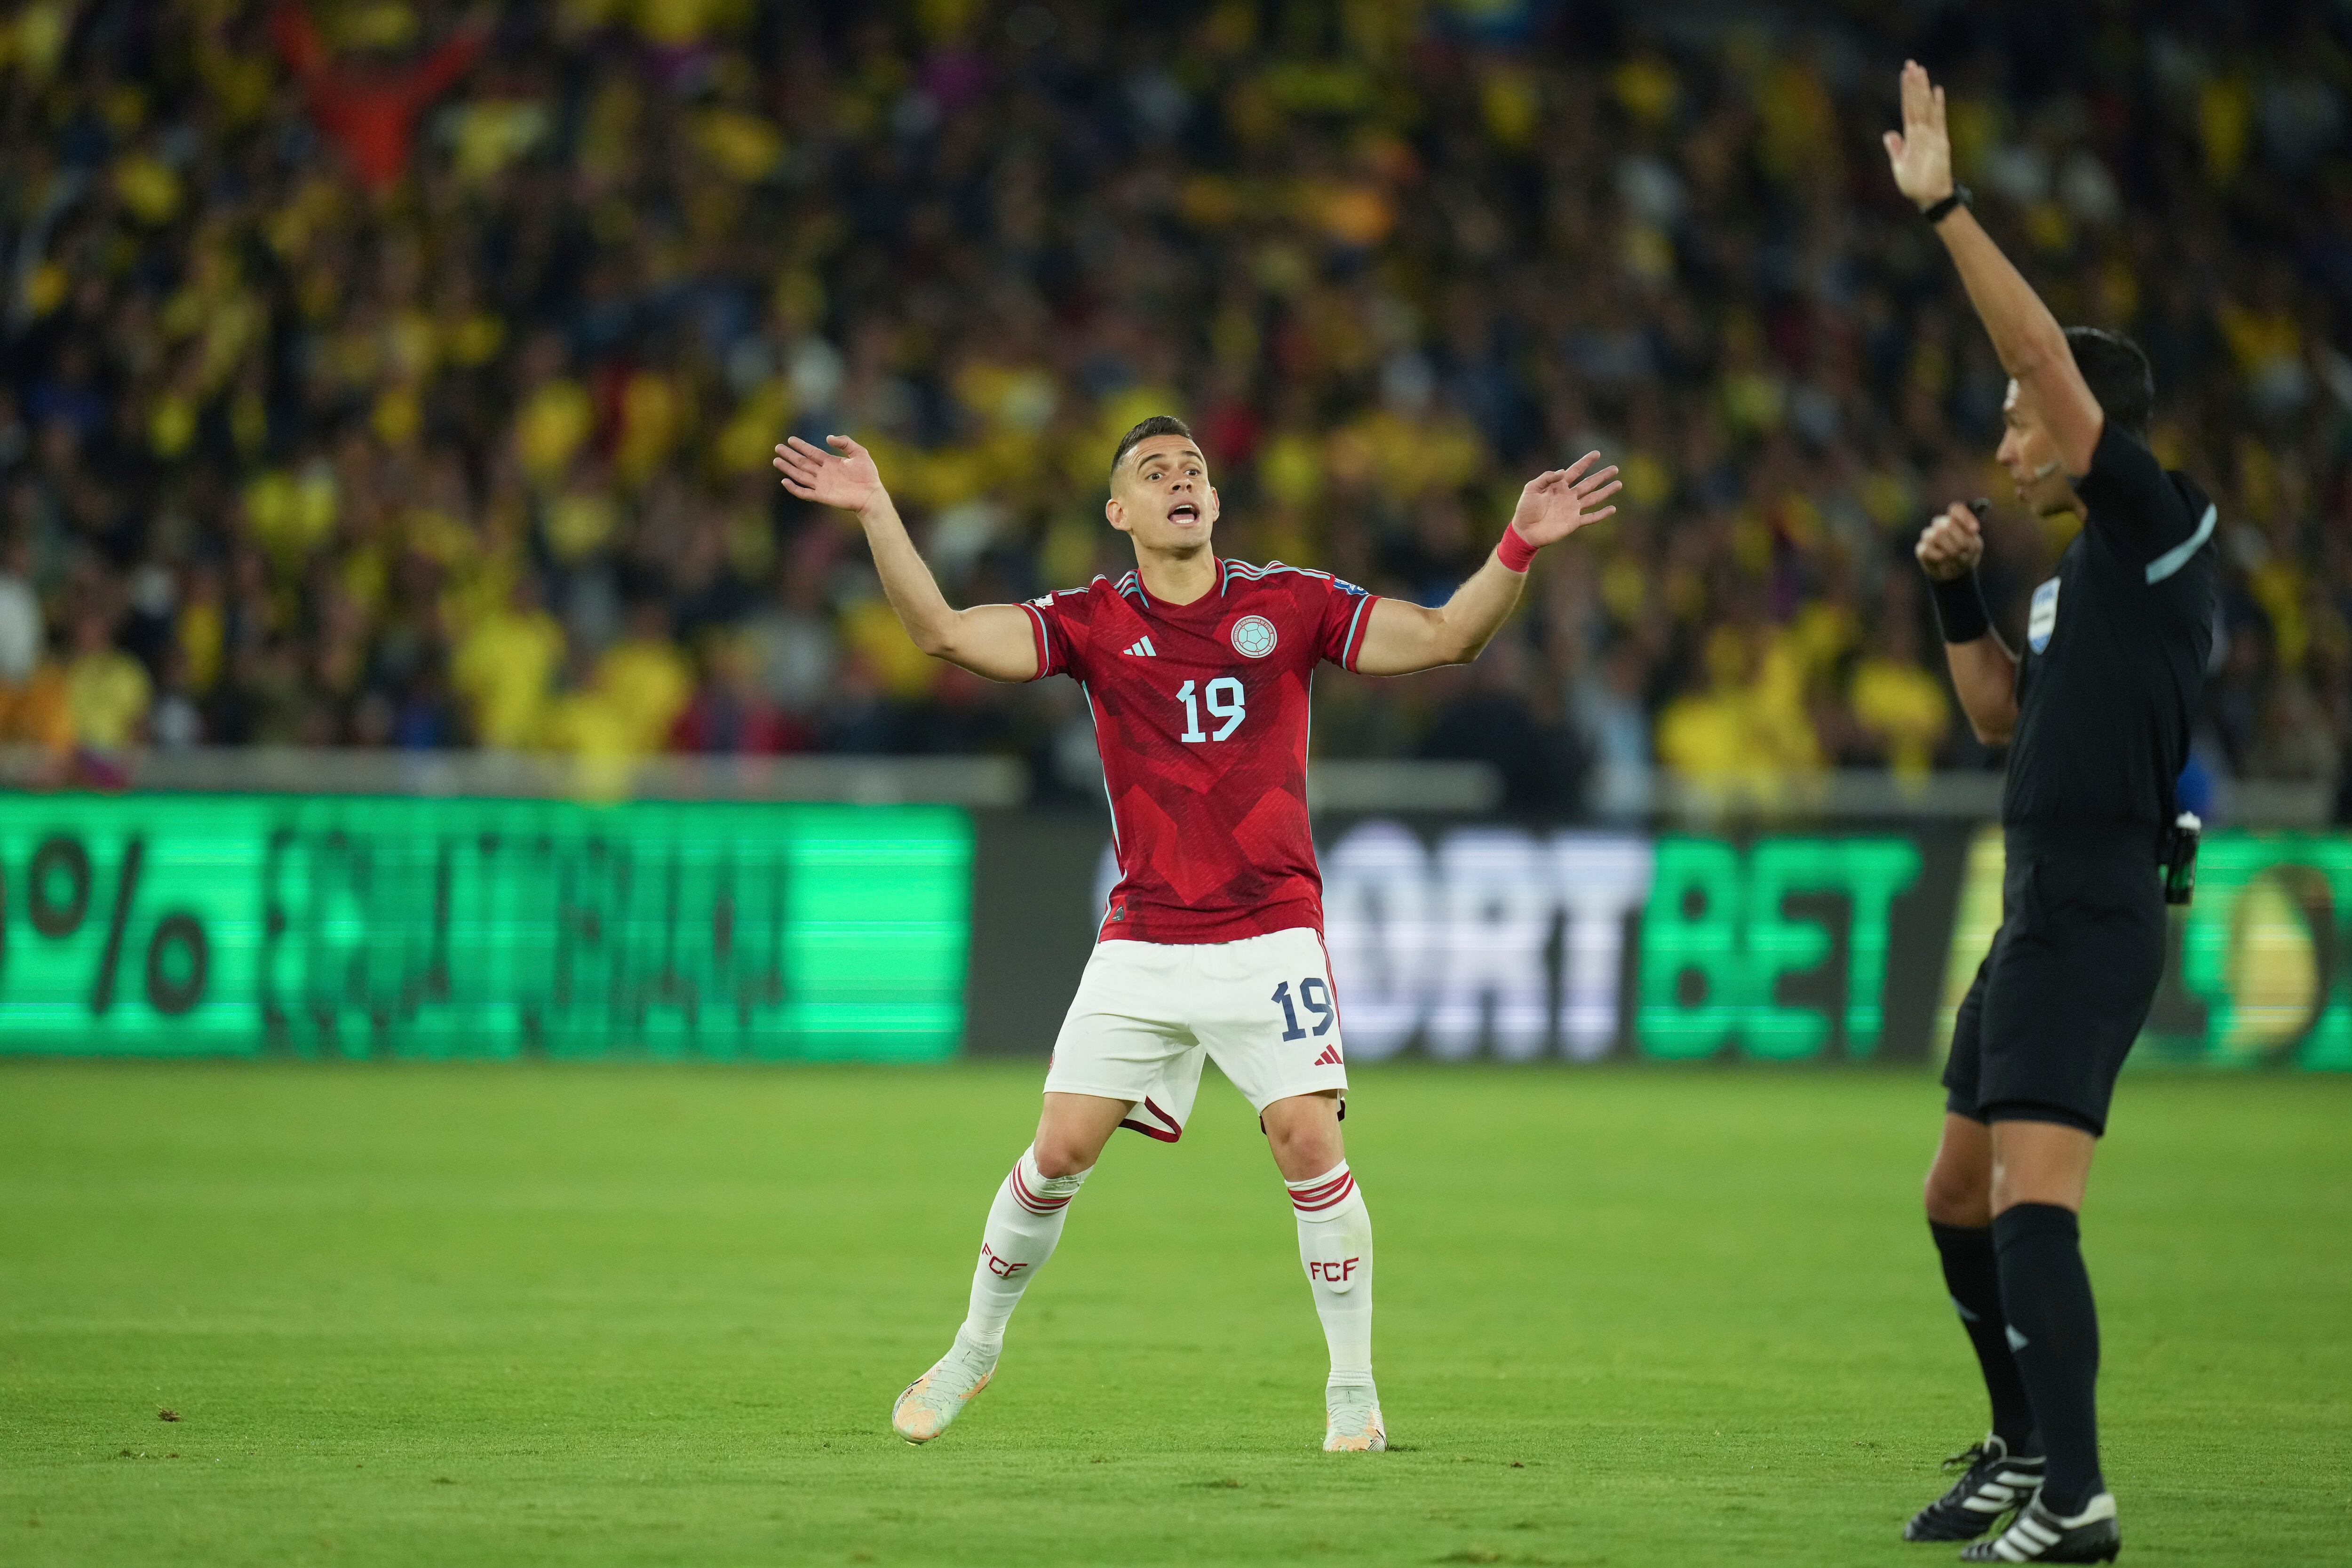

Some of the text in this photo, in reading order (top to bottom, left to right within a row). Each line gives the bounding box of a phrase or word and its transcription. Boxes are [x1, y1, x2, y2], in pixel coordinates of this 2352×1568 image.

[1176, 677, 1246, 743] 19
[1094, 821, 1923, 1061] ORTBET
[1271, 978, 1334, 1042] 19
[982, 1242, 1028, 1277] FCF
[1310, 1257, 1359, 1281] FCF
